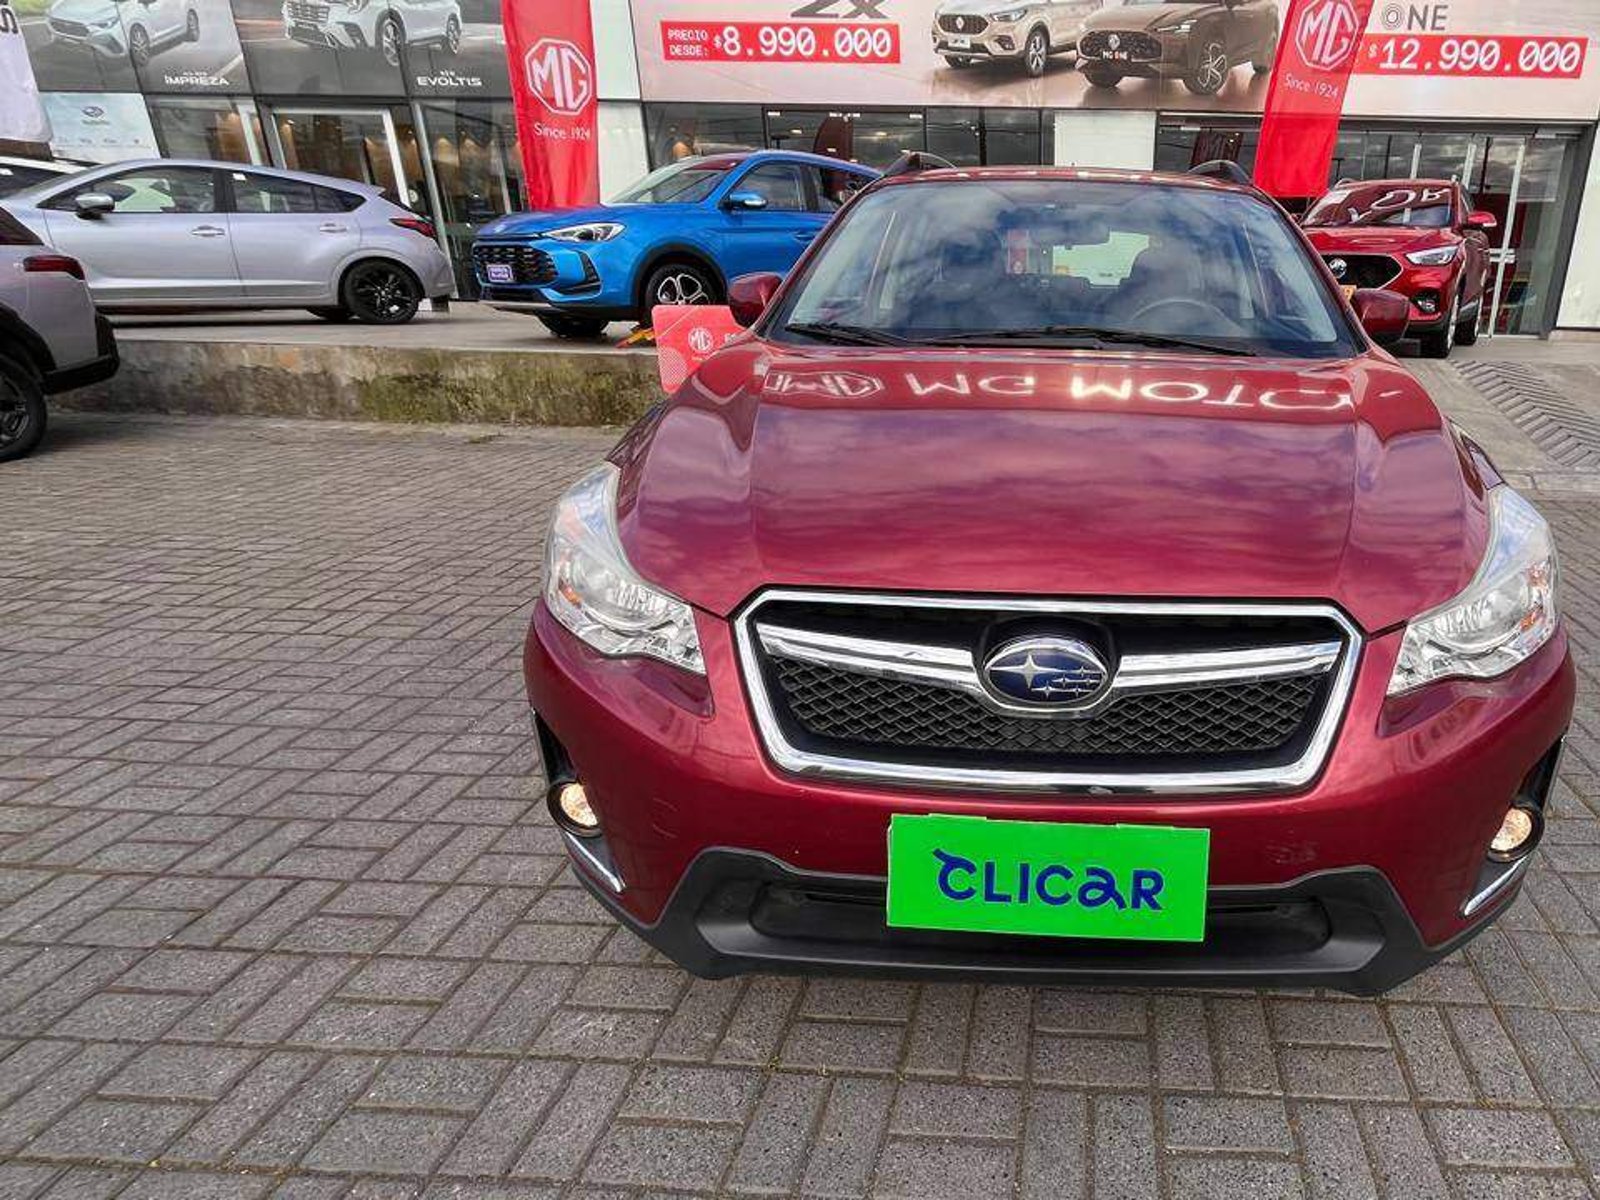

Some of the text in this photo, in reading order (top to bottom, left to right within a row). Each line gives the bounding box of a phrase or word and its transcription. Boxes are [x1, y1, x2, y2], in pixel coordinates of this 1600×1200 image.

[1381, 3, 1448, 31] ONE
[667, 28, 709, 41] PRECIO
[1299, 1, 1355, 65] MG
[669, 45, 709, 56] DESDE:
[1367, 38, 1582, 73] $12.990.000
[164, 75, 230, 86] IMPREZA
[416, 76, 482, 86] EVOLTIS
[530, 46, 589, 110] MG
[1285, 72, 1339, 99] Since 1924
[533, 121, 567, 140] Since
[689, 329, 712, 352] MG
